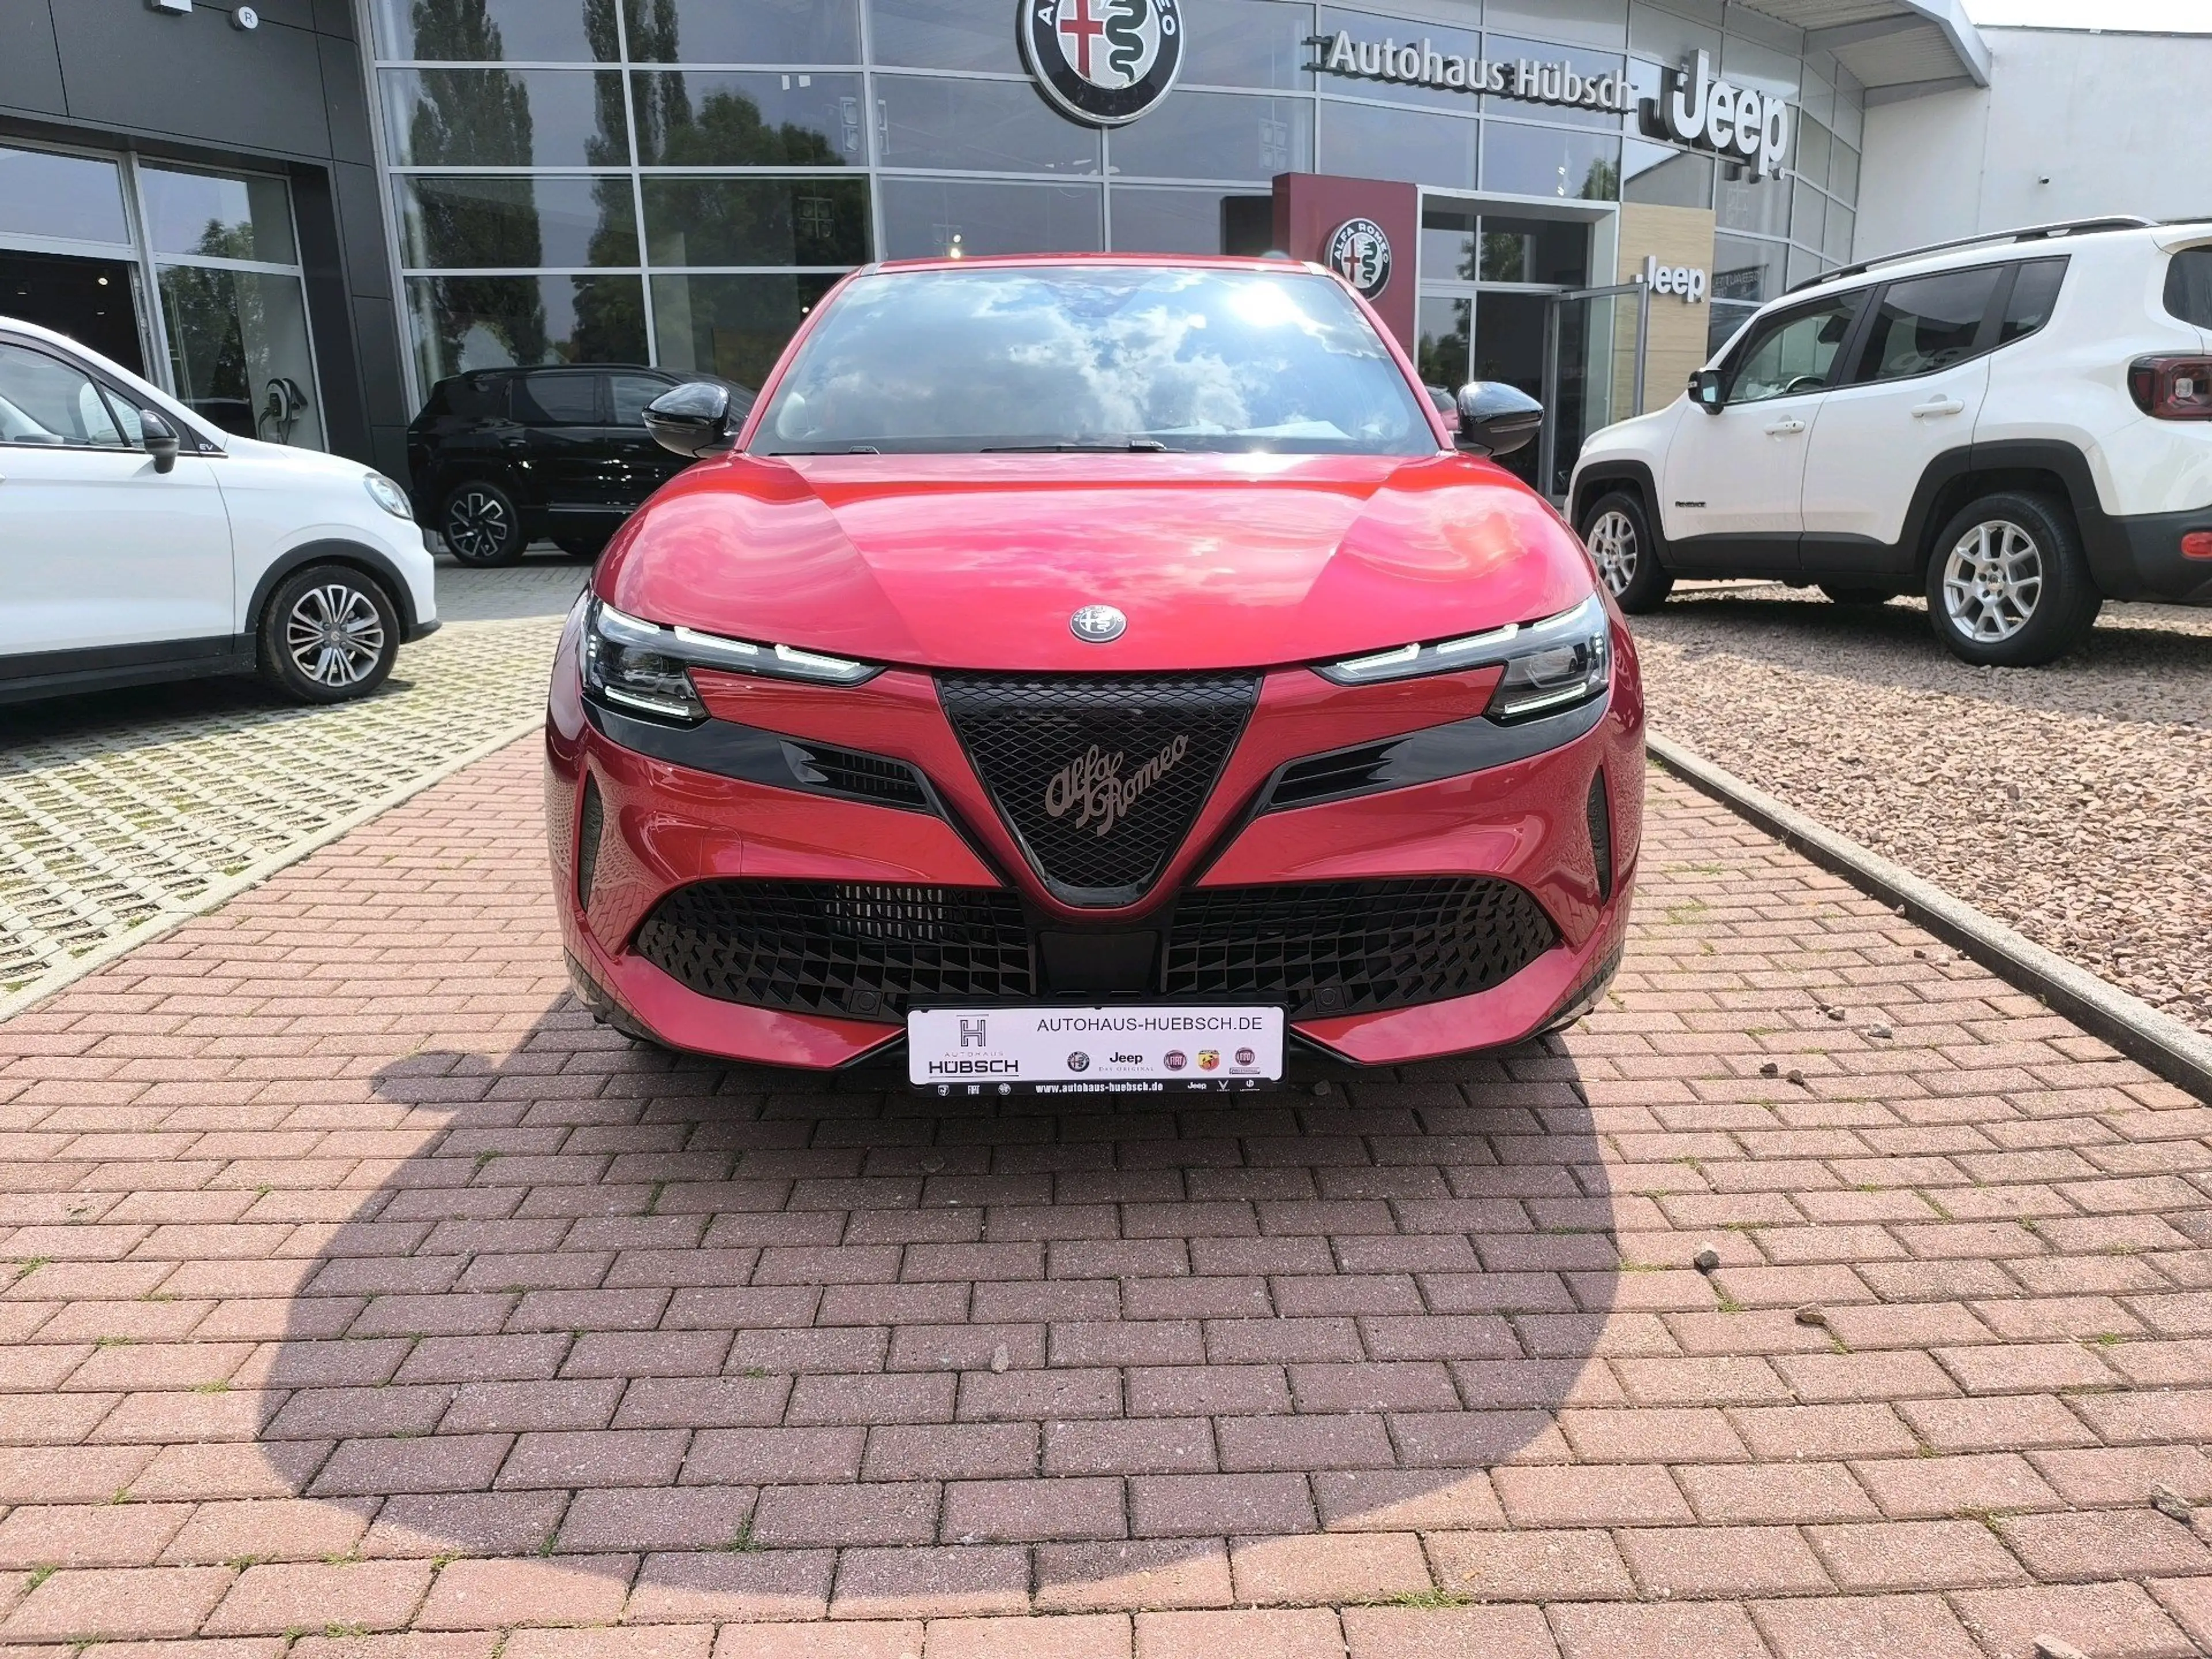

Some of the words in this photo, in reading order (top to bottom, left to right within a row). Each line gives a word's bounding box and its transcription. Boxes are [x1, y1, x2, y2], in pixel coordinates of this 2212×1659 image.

[1329, 30, 1505, 91] Autohaus
[1517, 58, 1630, 110] Hübsch
[1672, 48, 1788, 177] Jeep
[1334, 226, 1354, 260] ALFA
[1358, 222, 1389, 263] ROMEO
[1635, 255, 1706, 303] Jeep
[1044, 744, 1110, 830] Alfa
[1088, 734, 1189, 836] Romeo
[1036, 1017, 1263, 1032] AUTOHAUS-HUEBSCH.DE
[929, 1059, 1019, 1074] HÜBSCH
[1109, 1052, 1143, 1065] Jeep
[1035, 1081, 1164, 1093] www.autohaus-huebsch.de
